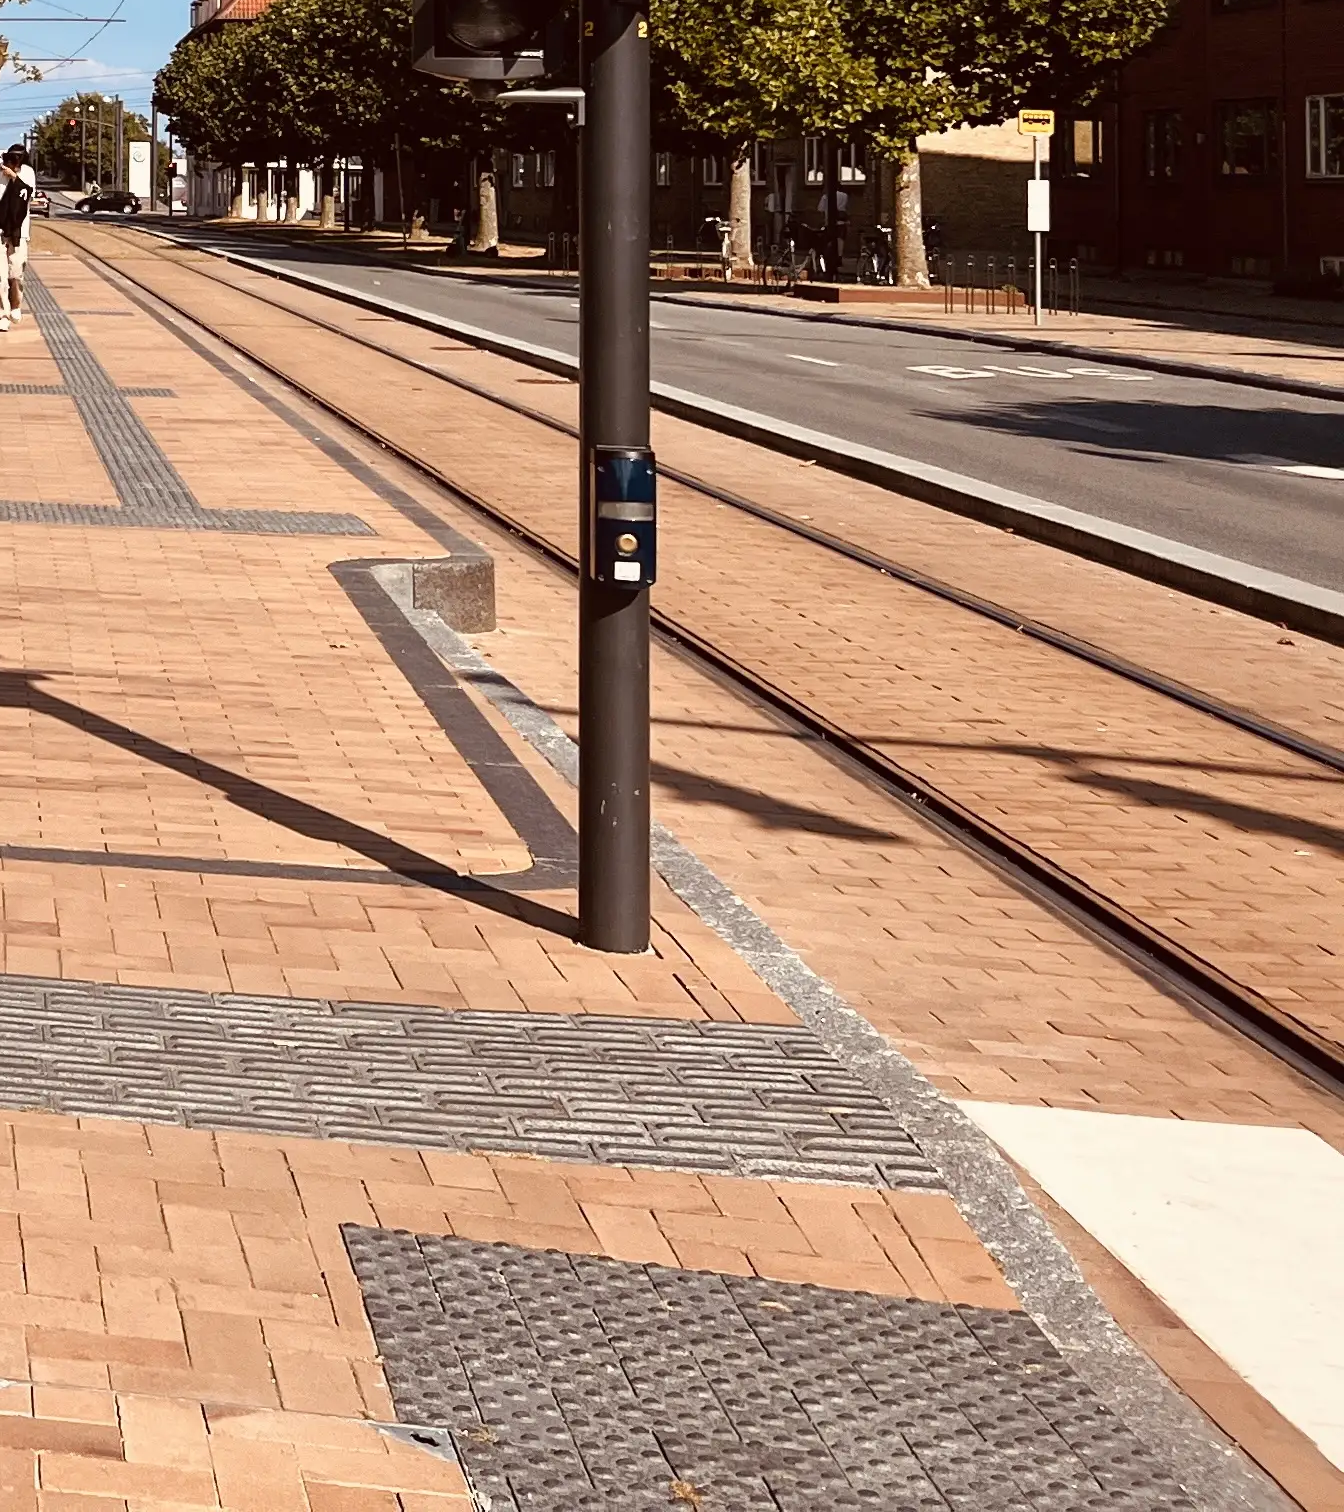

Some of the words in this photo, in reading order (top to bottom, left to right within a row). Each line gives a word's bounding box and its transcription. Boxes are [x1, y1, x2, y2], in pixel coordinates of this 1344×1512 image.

[584, 21, 594, 37] 2
[638, 21, 648, 38] 2
[905, 365, 1154, 380] BUS
